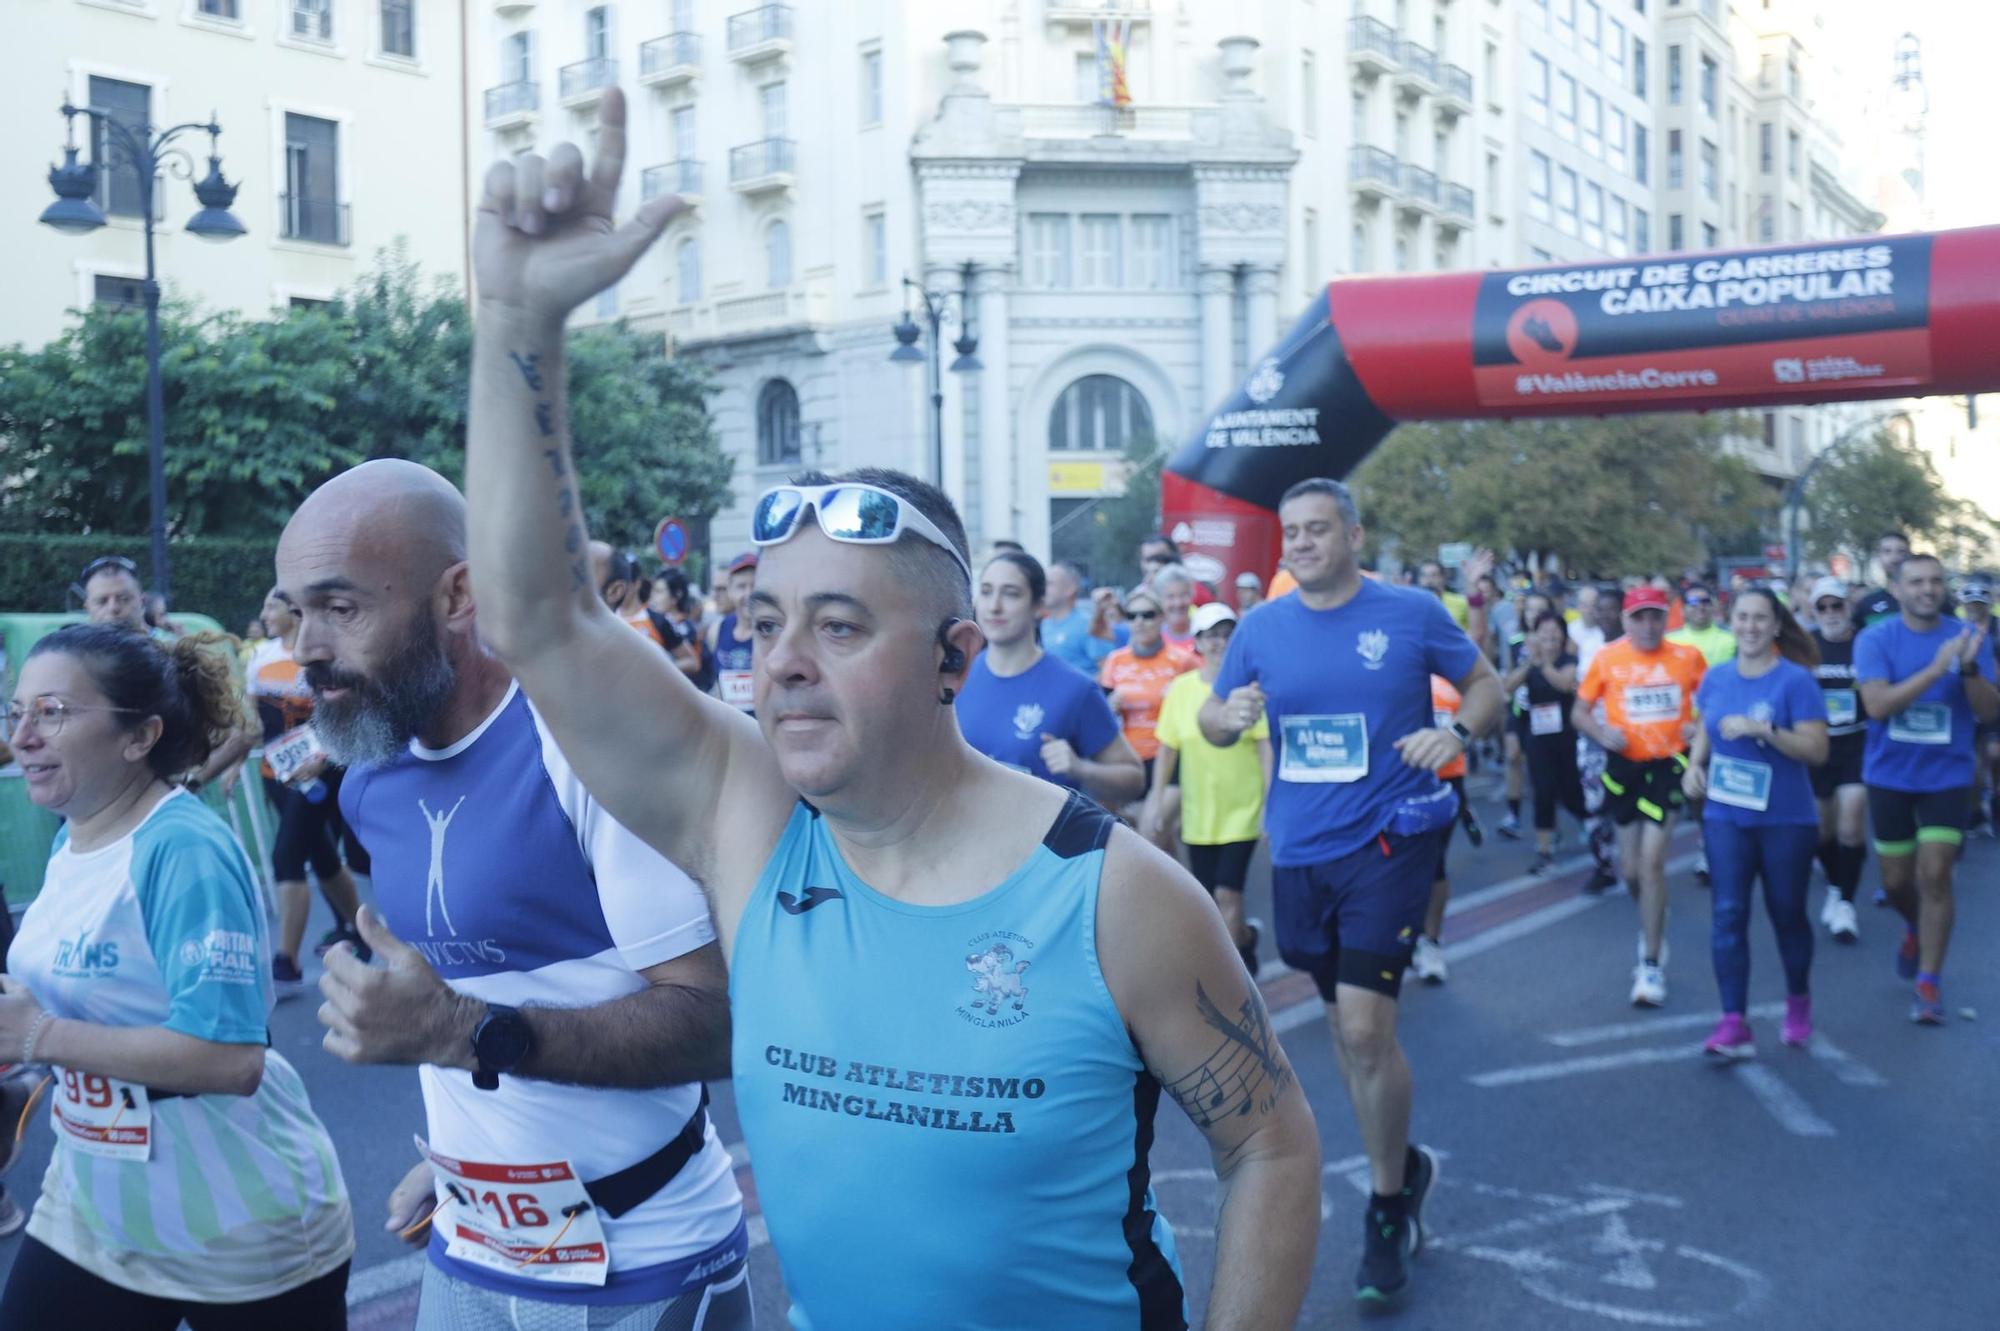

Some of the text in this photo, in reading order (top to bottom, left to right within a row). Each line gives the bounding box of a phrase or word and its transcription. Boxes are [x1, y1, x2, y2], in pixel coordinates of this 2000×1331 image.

[1507, 244, 1894, 296] CIRCUIT DE CARRERES
[1514, 367, 1719, 396] #ValènciaCorre
[955, 1006, 1030, 1029] MINGLANILLA
[765, 1045, 1046, 1099] CLUB ATLETISMO
[782, 1082, 1016, 1133] MINGLANILLA
